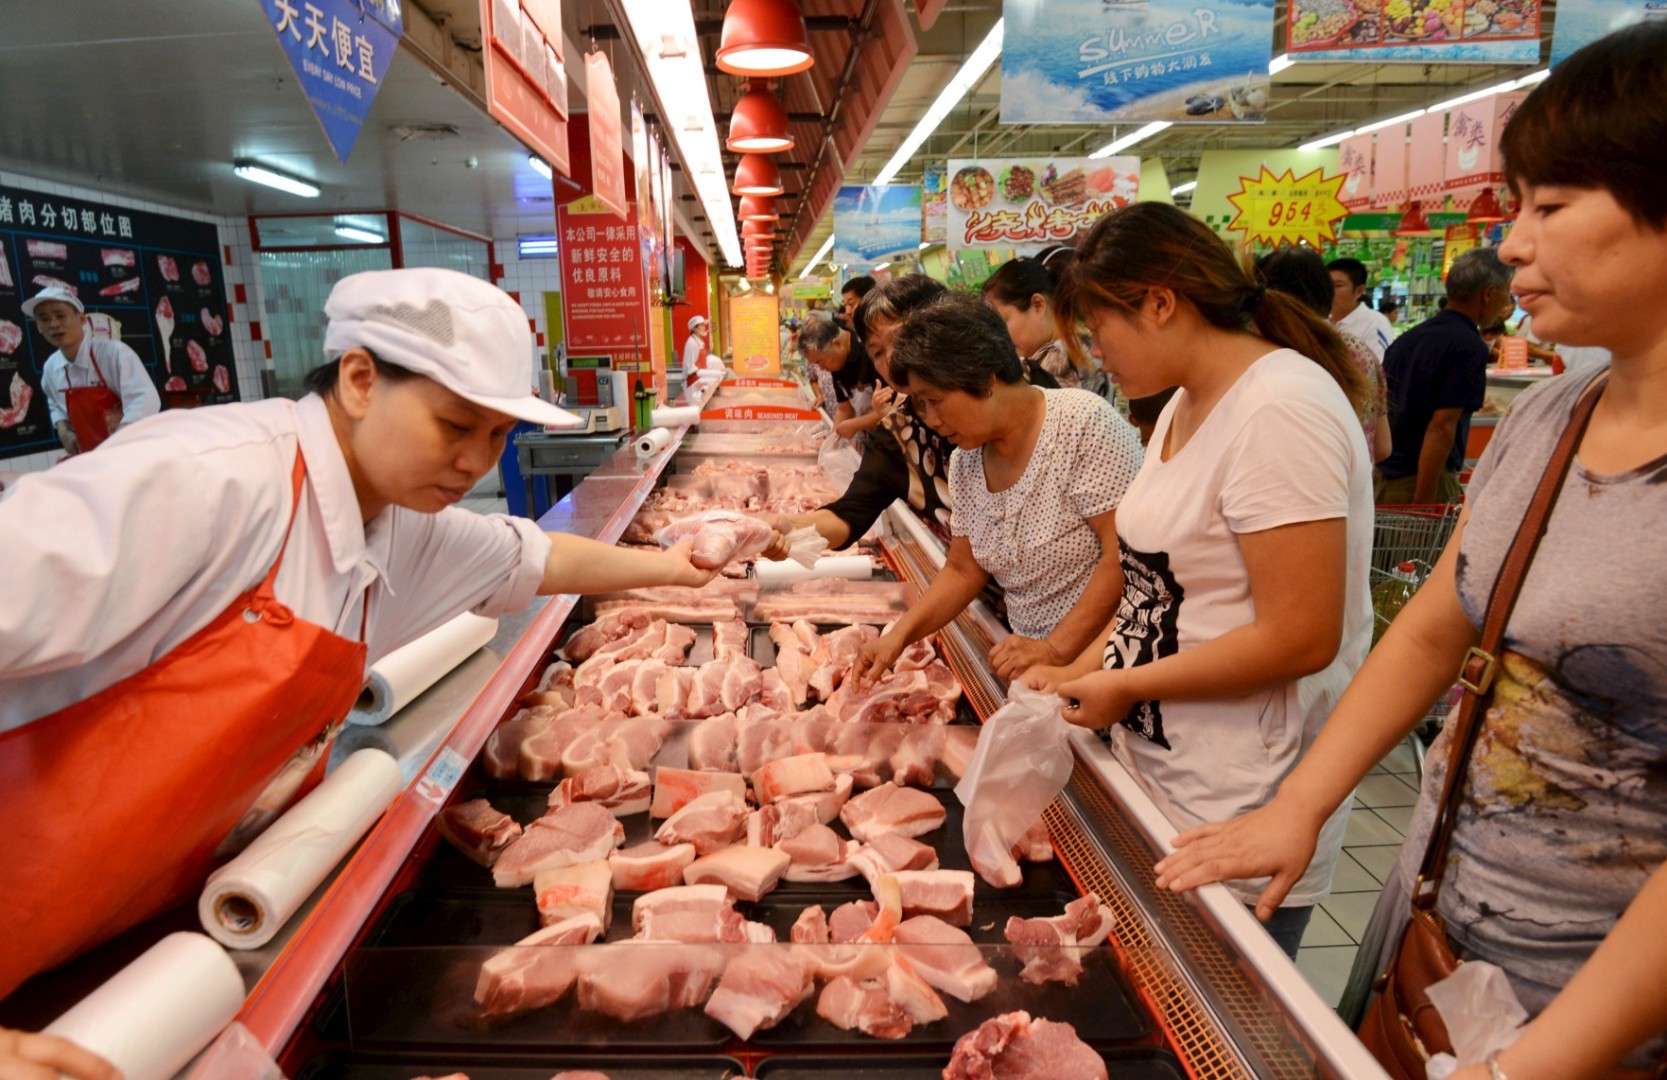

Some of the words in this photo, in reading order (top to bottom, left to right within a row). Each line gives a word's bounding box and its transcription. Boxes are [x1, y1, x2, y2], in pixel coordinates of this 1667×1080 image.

[275, 0, 377, 84] 天天便宜
[1452, 110, 1485, 149] 禽类
[0, 196, 133, 238] 猪肉分切部位图
[566, 226, 636, 242] 本公司一律采用
[571, 246, 634, 264] 新鲜安全的
[573, 267, 622, 283] 优良原料
